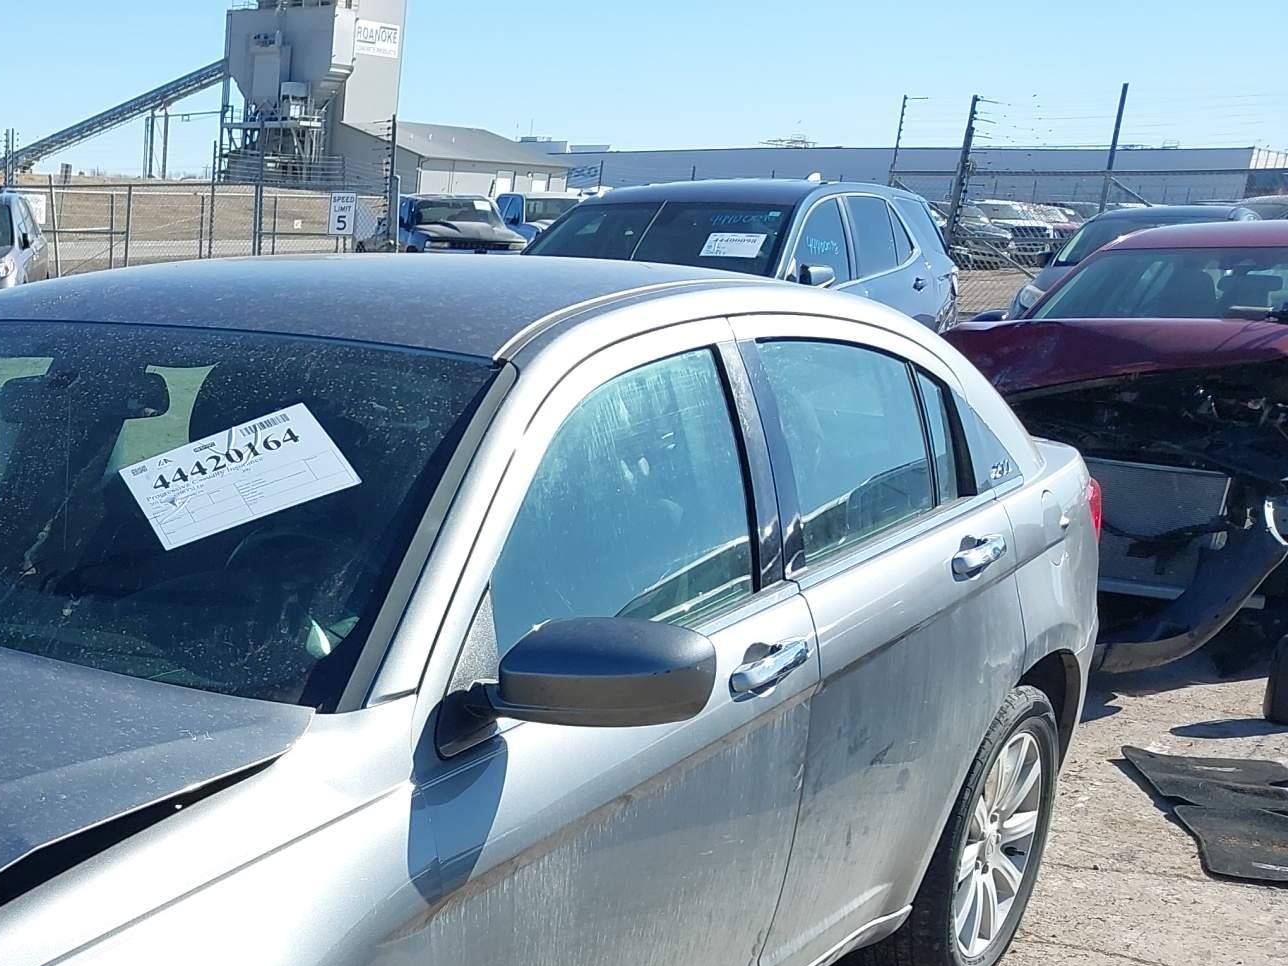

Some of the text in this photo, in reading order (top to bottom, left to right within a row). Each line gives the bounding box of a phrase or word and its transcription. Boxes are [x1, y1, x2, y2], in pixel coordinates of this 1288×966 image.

[357, 26, 398, 44] ROANOKE
[336, 215, 347, 231] 5
[153, 427, 300, 489] 44420164
